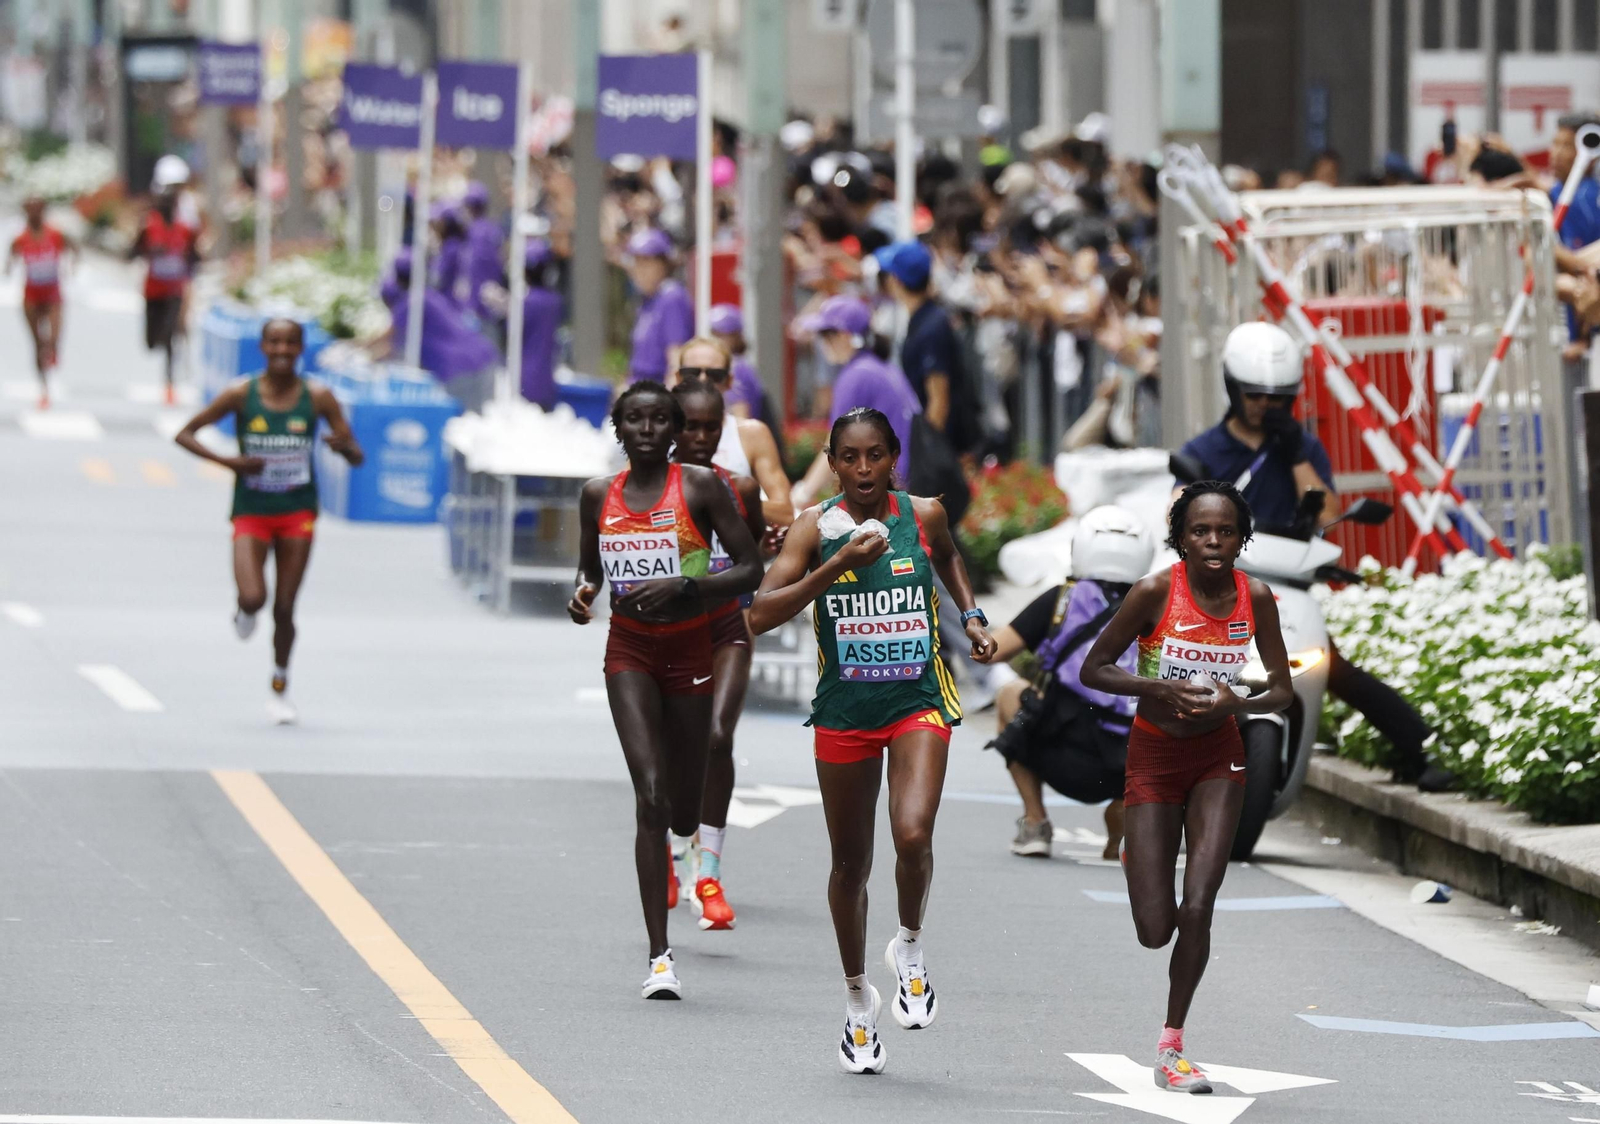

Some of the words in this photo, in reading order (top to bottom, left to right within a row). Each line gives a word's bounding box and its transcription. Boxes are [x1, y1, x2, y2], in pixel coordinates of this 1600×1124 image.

[344, 88, 420, 127] Water
[453, 85, 503, 121] Ice
[601, 88, 698, 123] Sponge
[600, 539, 676, 552] HONDA
[604, 557, 674, 578] MASAI
[826, 586, 926, 617] ETHIOPIA
[838, 619, 926, 635] HONDA
[844, 640, 926, 663] ASSEFA
[1166, 645, 1248, 664] HONDA
